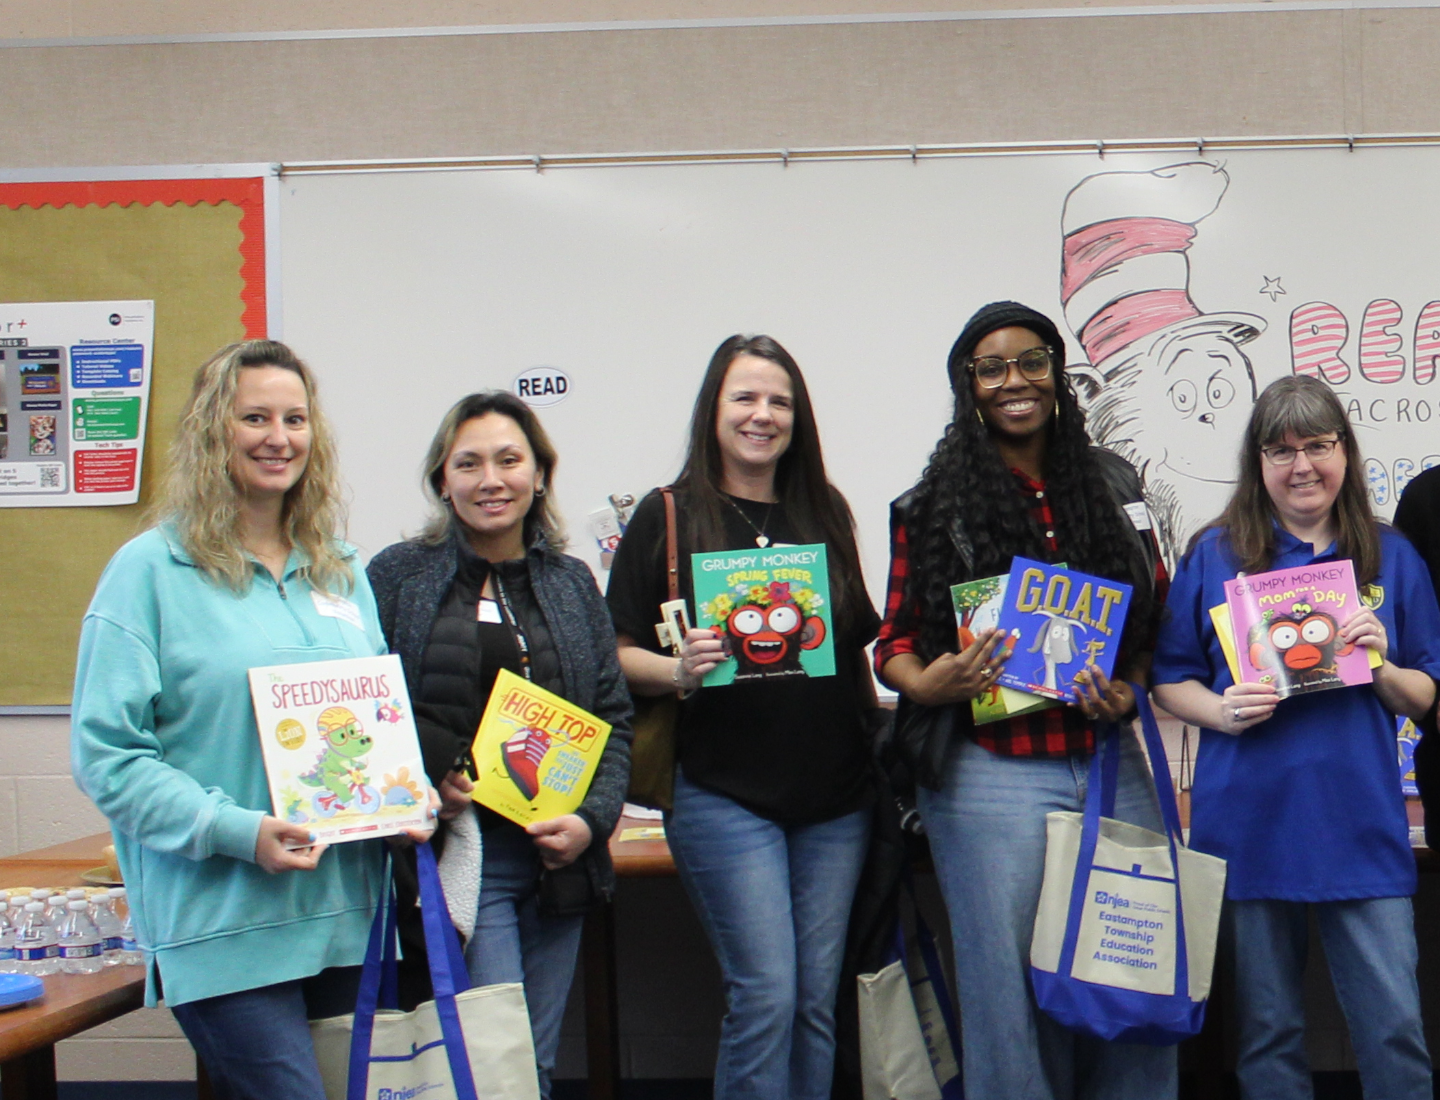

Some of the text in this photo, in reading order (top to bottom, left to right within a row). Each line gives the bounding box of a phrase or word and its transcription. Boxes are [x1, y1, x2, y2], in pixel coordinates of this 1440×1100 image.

[518, 376, 568, 397] READ
[701, 551, 818, 572] GRUMPY MONKEY
[726, 567, 814, 587] SPRING FEVER
[1234, 568, 1345, 597] GRUMPY MONKEY
[1016, 567, 1123, 636] G.O.A.T.
[272, 674, 391, 709] SPEEDYSAURUS
[503, 692, 598, 744] HIGH TOP
[542, 776, 574, 796] STOP!
[548, 766, 580, 786] CAN'T
[1107, 892, 1130, 909] njea
[1099, 911, 1164, 931] Eastampton
[1104, 925, 1155, 944] Township
[1100, 938, 1154, 957] Education
[1093, 951, 1158, 971] Association
